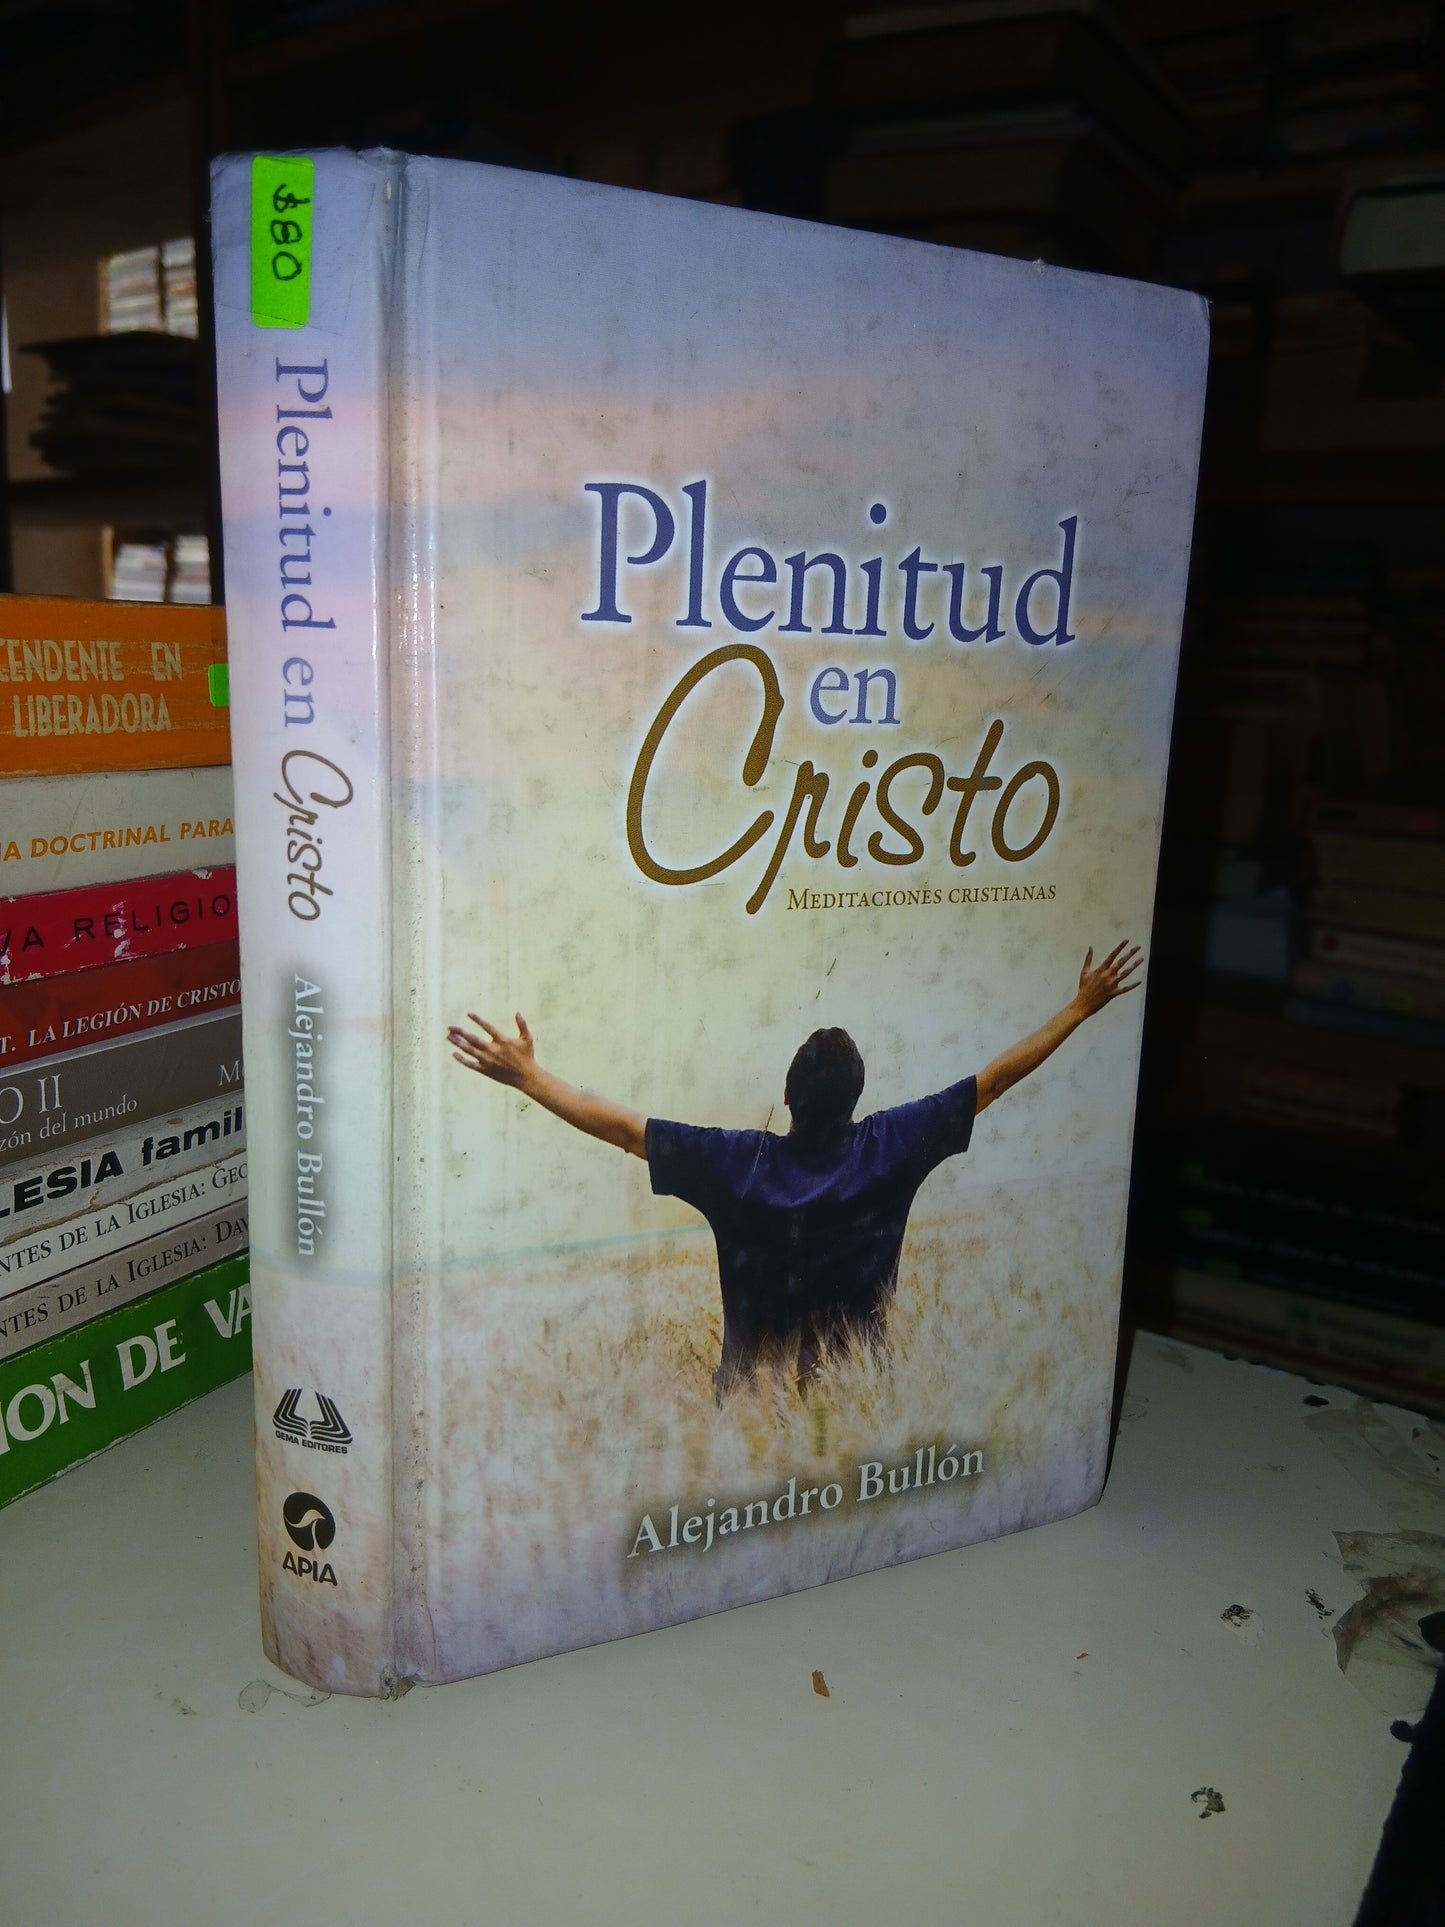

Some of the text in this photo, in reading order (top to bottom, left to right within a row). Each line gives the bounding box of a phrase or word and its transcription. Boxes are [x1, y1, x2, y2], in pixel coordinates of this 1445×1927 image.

[270, 184, 311, 281] $80
[580, 479, 1078, 646] Plenitud
[150, 641, 183, 681] EN
[273, 356, 354, 921] Plenitud en Cristo
[13, 693, 172, 738] LIBERADORA
[809, 666, 901, 726] en
[626, 643, 1061, 915] Cristo
[0, 818, 235, 862] A DOCTRINAL PARA
[74, 894, 232, 942] RELIGIO
[786, 884, 1058, 911] MEDITACIONES CRISTIANAS
[29, 1025, 57, 1048] LA
[63, 1002, 143, 1039] LEGIÓN
[147, 995, 173, 1017] DE
[177, 978, 241, 1009] CRISTO
[37, 1073, 63, 1114] II
[219, 1059, 244, 1087] M
[39, 1112, 67, 1140] del
[74, 1093, 138, 1130] mundo
[141, 1106, 243, 1167] famil
[288, 973, 327, 1257] Alejandro Bullón
[59, 1225, 89, 1252] DE
[95, 1214, 121, 1238] LA
[57, 1286, 88, 1314] DE
[95, 1273, 120, 1298] LA
[115, 1318, 187, 1392] DE
[301, 1438, 349, 1455] EDITORES
[626, 1443, 985, 1559] Alejandro Bullón
[282, 1550, 338, 1587] APIA
